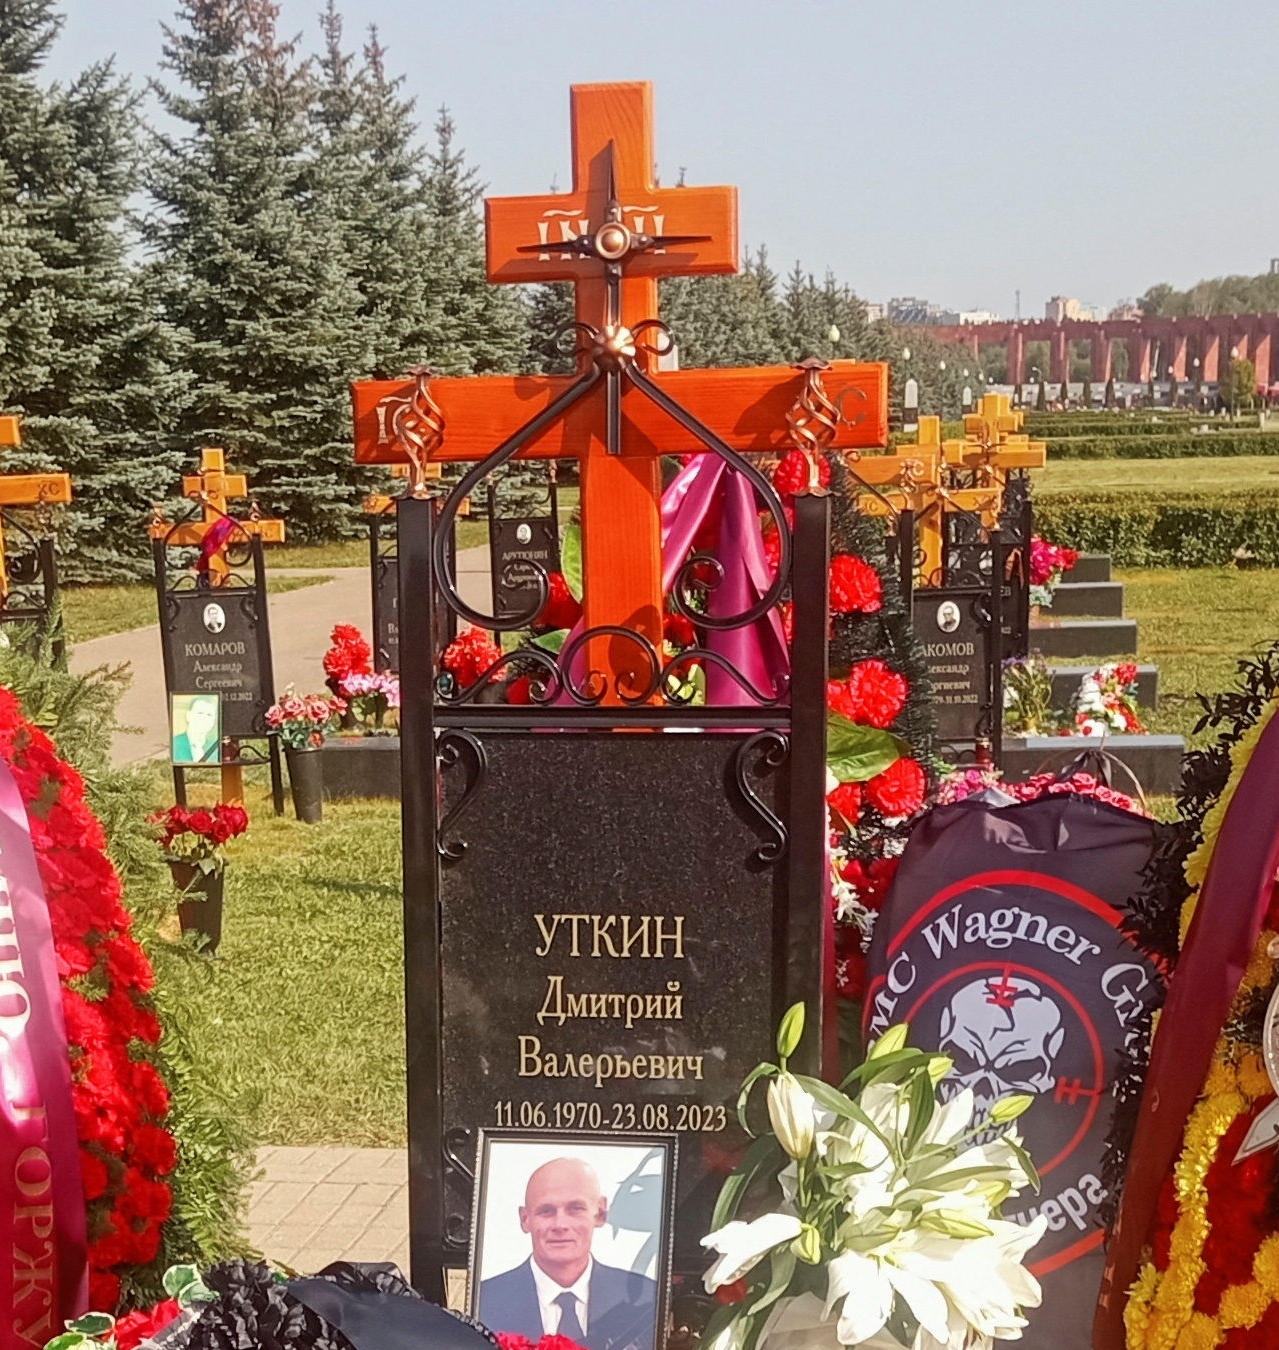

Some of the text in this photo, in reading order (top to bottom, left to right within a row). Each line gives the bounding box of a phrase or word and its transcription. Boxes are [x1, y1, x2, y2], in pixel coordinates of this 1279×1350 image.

[184, 641, 246, 657] КОМАРОВ
[193, 660, 243, 674] Александр
[195, 676, 243, 690] Сергеевич
[533, 913, 685, 959] УТКИН
[920, 903, 1103, 967] Wagner
[536, 975, 684, 1029] Дмитрий
[517, 1034, 704, 1089] Валерьевич
[493, 1099, 728, 1133] 11.06.1970-23.08.2023
